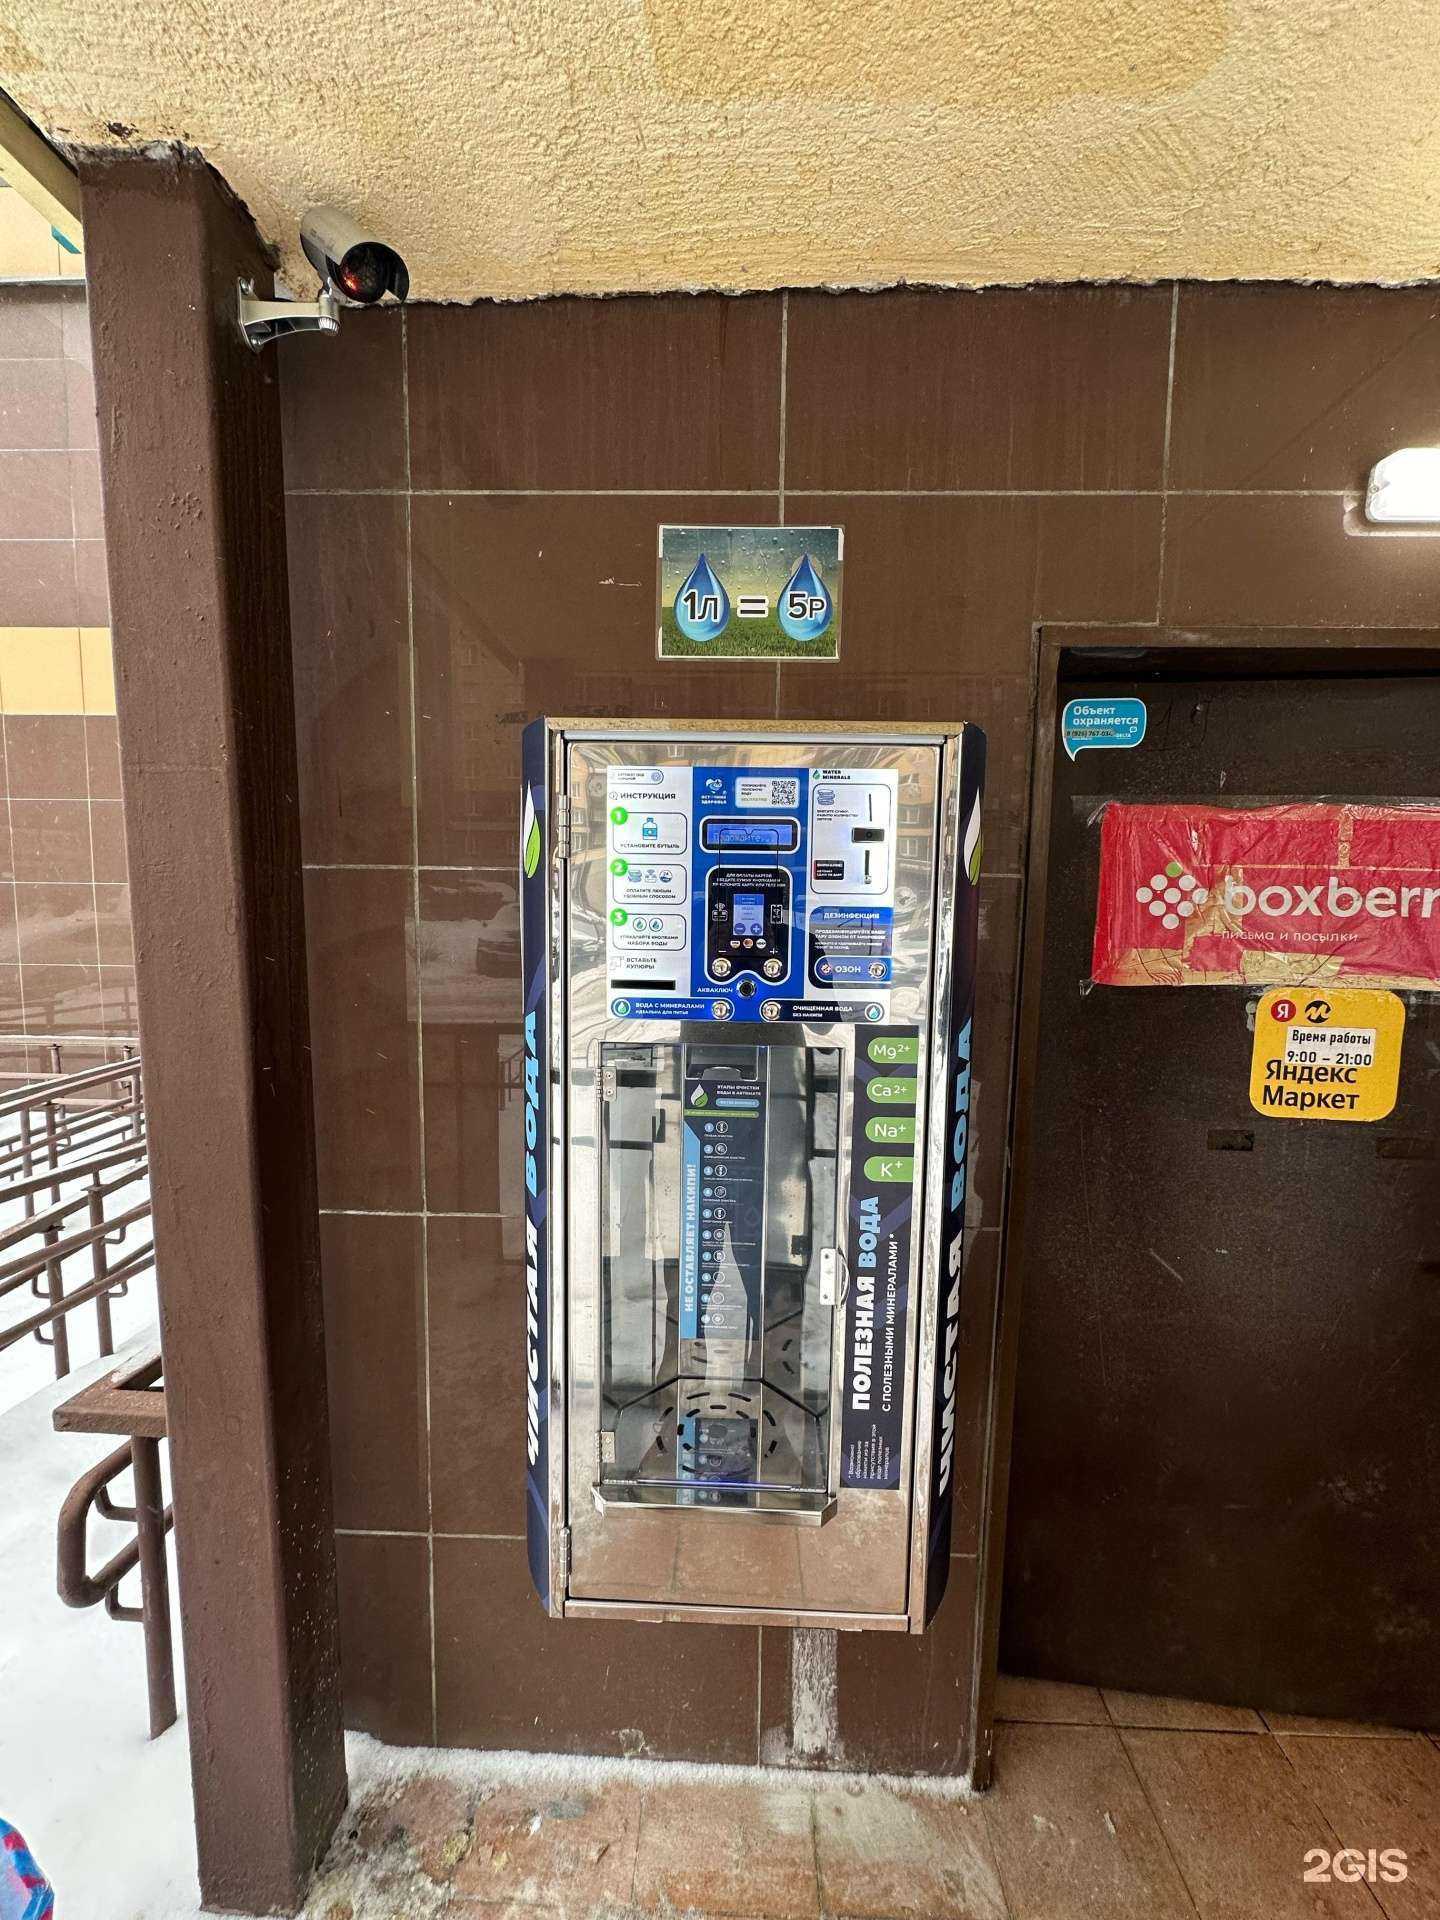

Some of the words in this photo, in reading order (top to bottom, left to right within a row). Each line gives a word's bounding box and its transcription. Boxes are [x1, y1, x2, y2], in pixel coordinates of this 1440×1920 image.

[1072, 717, 1139, 727] охраняется
[1073, 705, 1116, 716] Объект
[620, 792, 676, 800] ИНСТРУКЦИЯ
[1224, 874, 1440, 919] boxberr
[1222, 929, 1275, 941] письма
[1279, 931, 1289, 940] и
[1293, 931, 1359, 942] посылки
[834, 965, 861, 973] ОЗОН
[1292, 1029, 1326, 1045] Время
[1330, 1032, 1371, 1045] работы
[1287, 1050, 1317, 1063] 9:00
[1336, 1053, 1372, 1066] 21:00
[1265, 1059, 1358, 1085] Яндекс
[525, 1010, 540, 1198] ВОДА
[1262, 1085, 1360, 1110] Маркет
[686, 1164, 697, 1220] НАКИПИ!
[858, 1196, 881, 1268] ВОДА
[685, 1222, 695, 1295] ОСТАВЛЯЕТ
[939, 1227, 963, 1497] ЧИСТАЯ
[951, 1016, 972, 1213] ВОДА
[887, 1241, 898, 1326] МИНЕРАЛАМИ
[685, 1296, 694, 1312] НЕ
[526, 1214, 540, 1467] ЧИСТАЯ
[852, 1276, 875, 1411] ПОЛЕЗНАЯ
[882, 1327, 894, 1403] ПОЛЕЗНЫМИ
[882, 1403, 891, 1412] С
